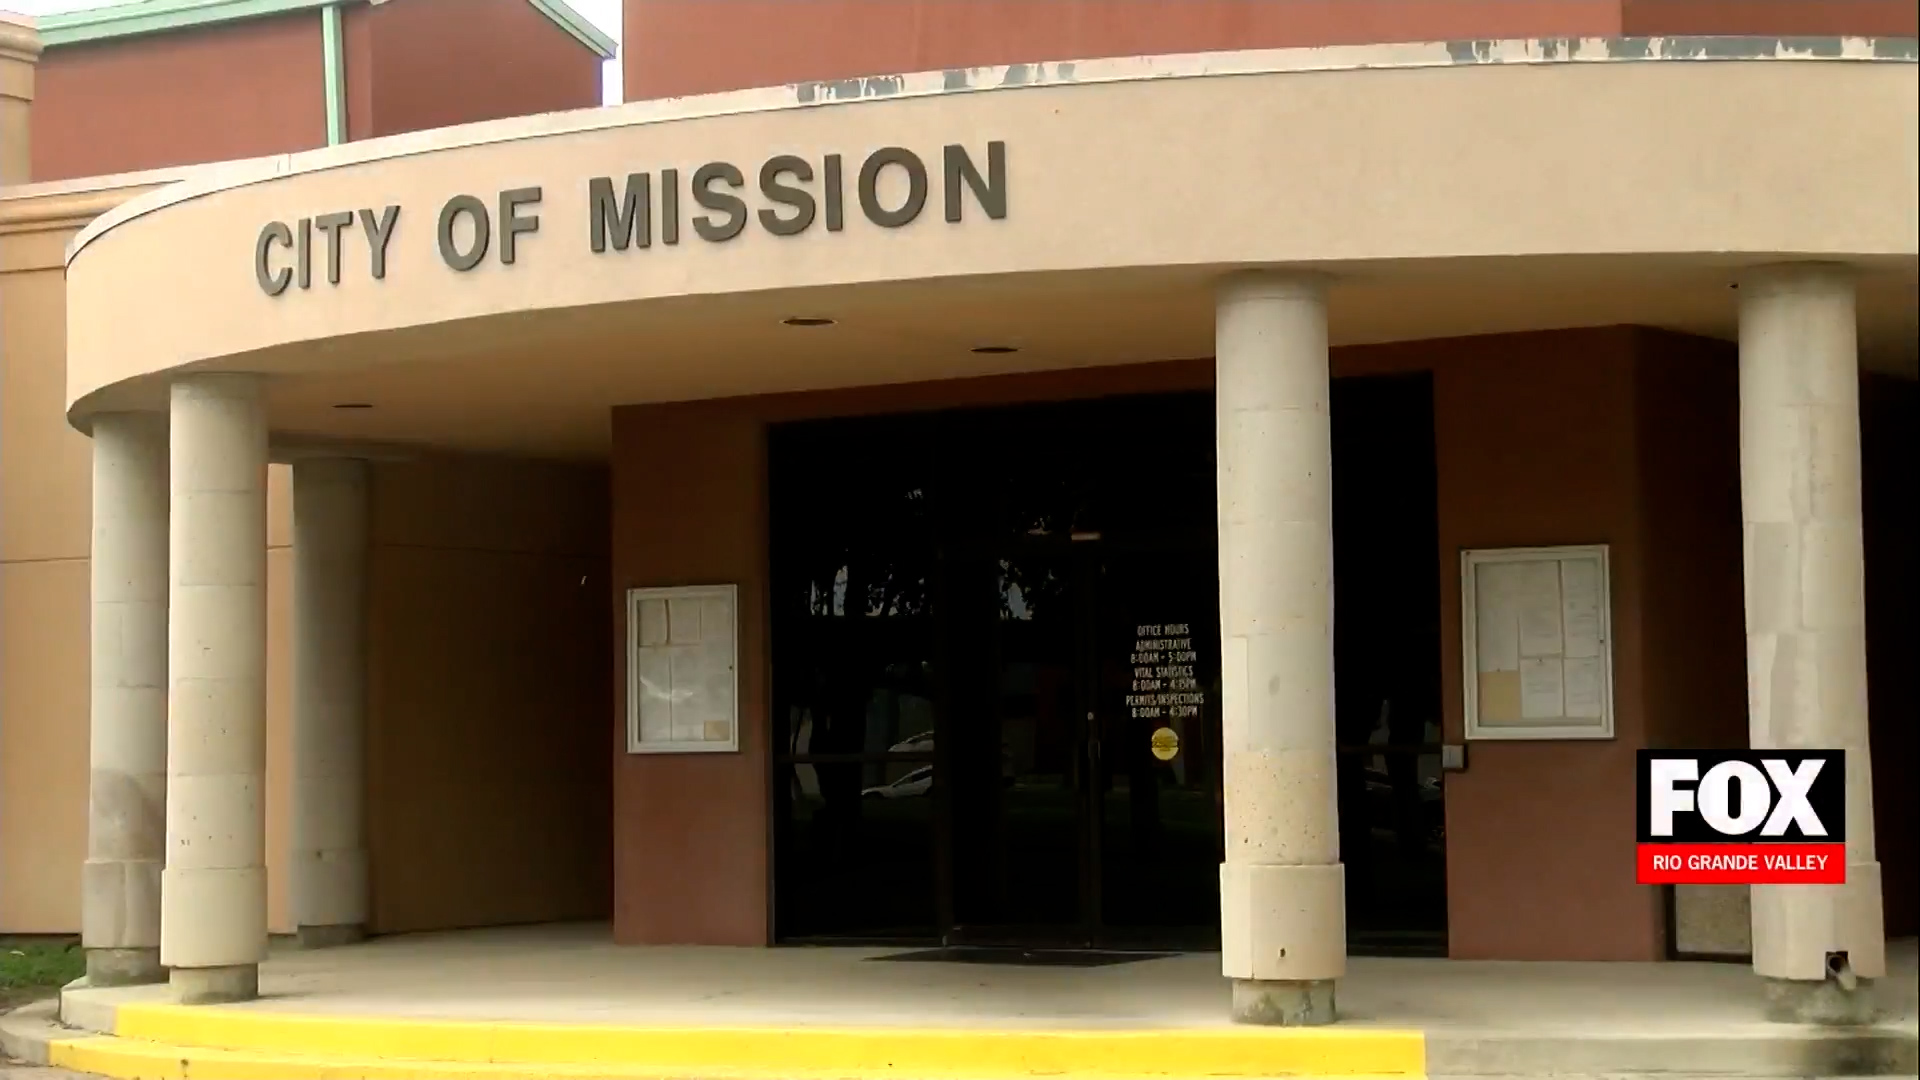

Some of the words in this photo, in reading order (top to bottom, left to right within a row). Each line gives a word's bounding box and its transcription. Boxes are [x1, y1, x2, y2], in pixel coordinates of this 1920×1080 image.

[255, 205, 400, 297] CITY
[437, 186, 542, 272] OF
[589, 140, 1007, 252] MISSION
[1137, 624, 1162, 636] OFFICE
[1165, 624, 1189, 635] HOURS
[1136, 638, 1192, 651] ADMINISTRATIVE
[1131, 652, 1159, 663] 8:00AM
[1168, 651, 1197, 663] 5:00PM
[1134, 667, 1153, 678] VITAL
[1156, 665, 1193, 678] STATISTICS
[1132, 707, 1160, 718] 8:00AM
